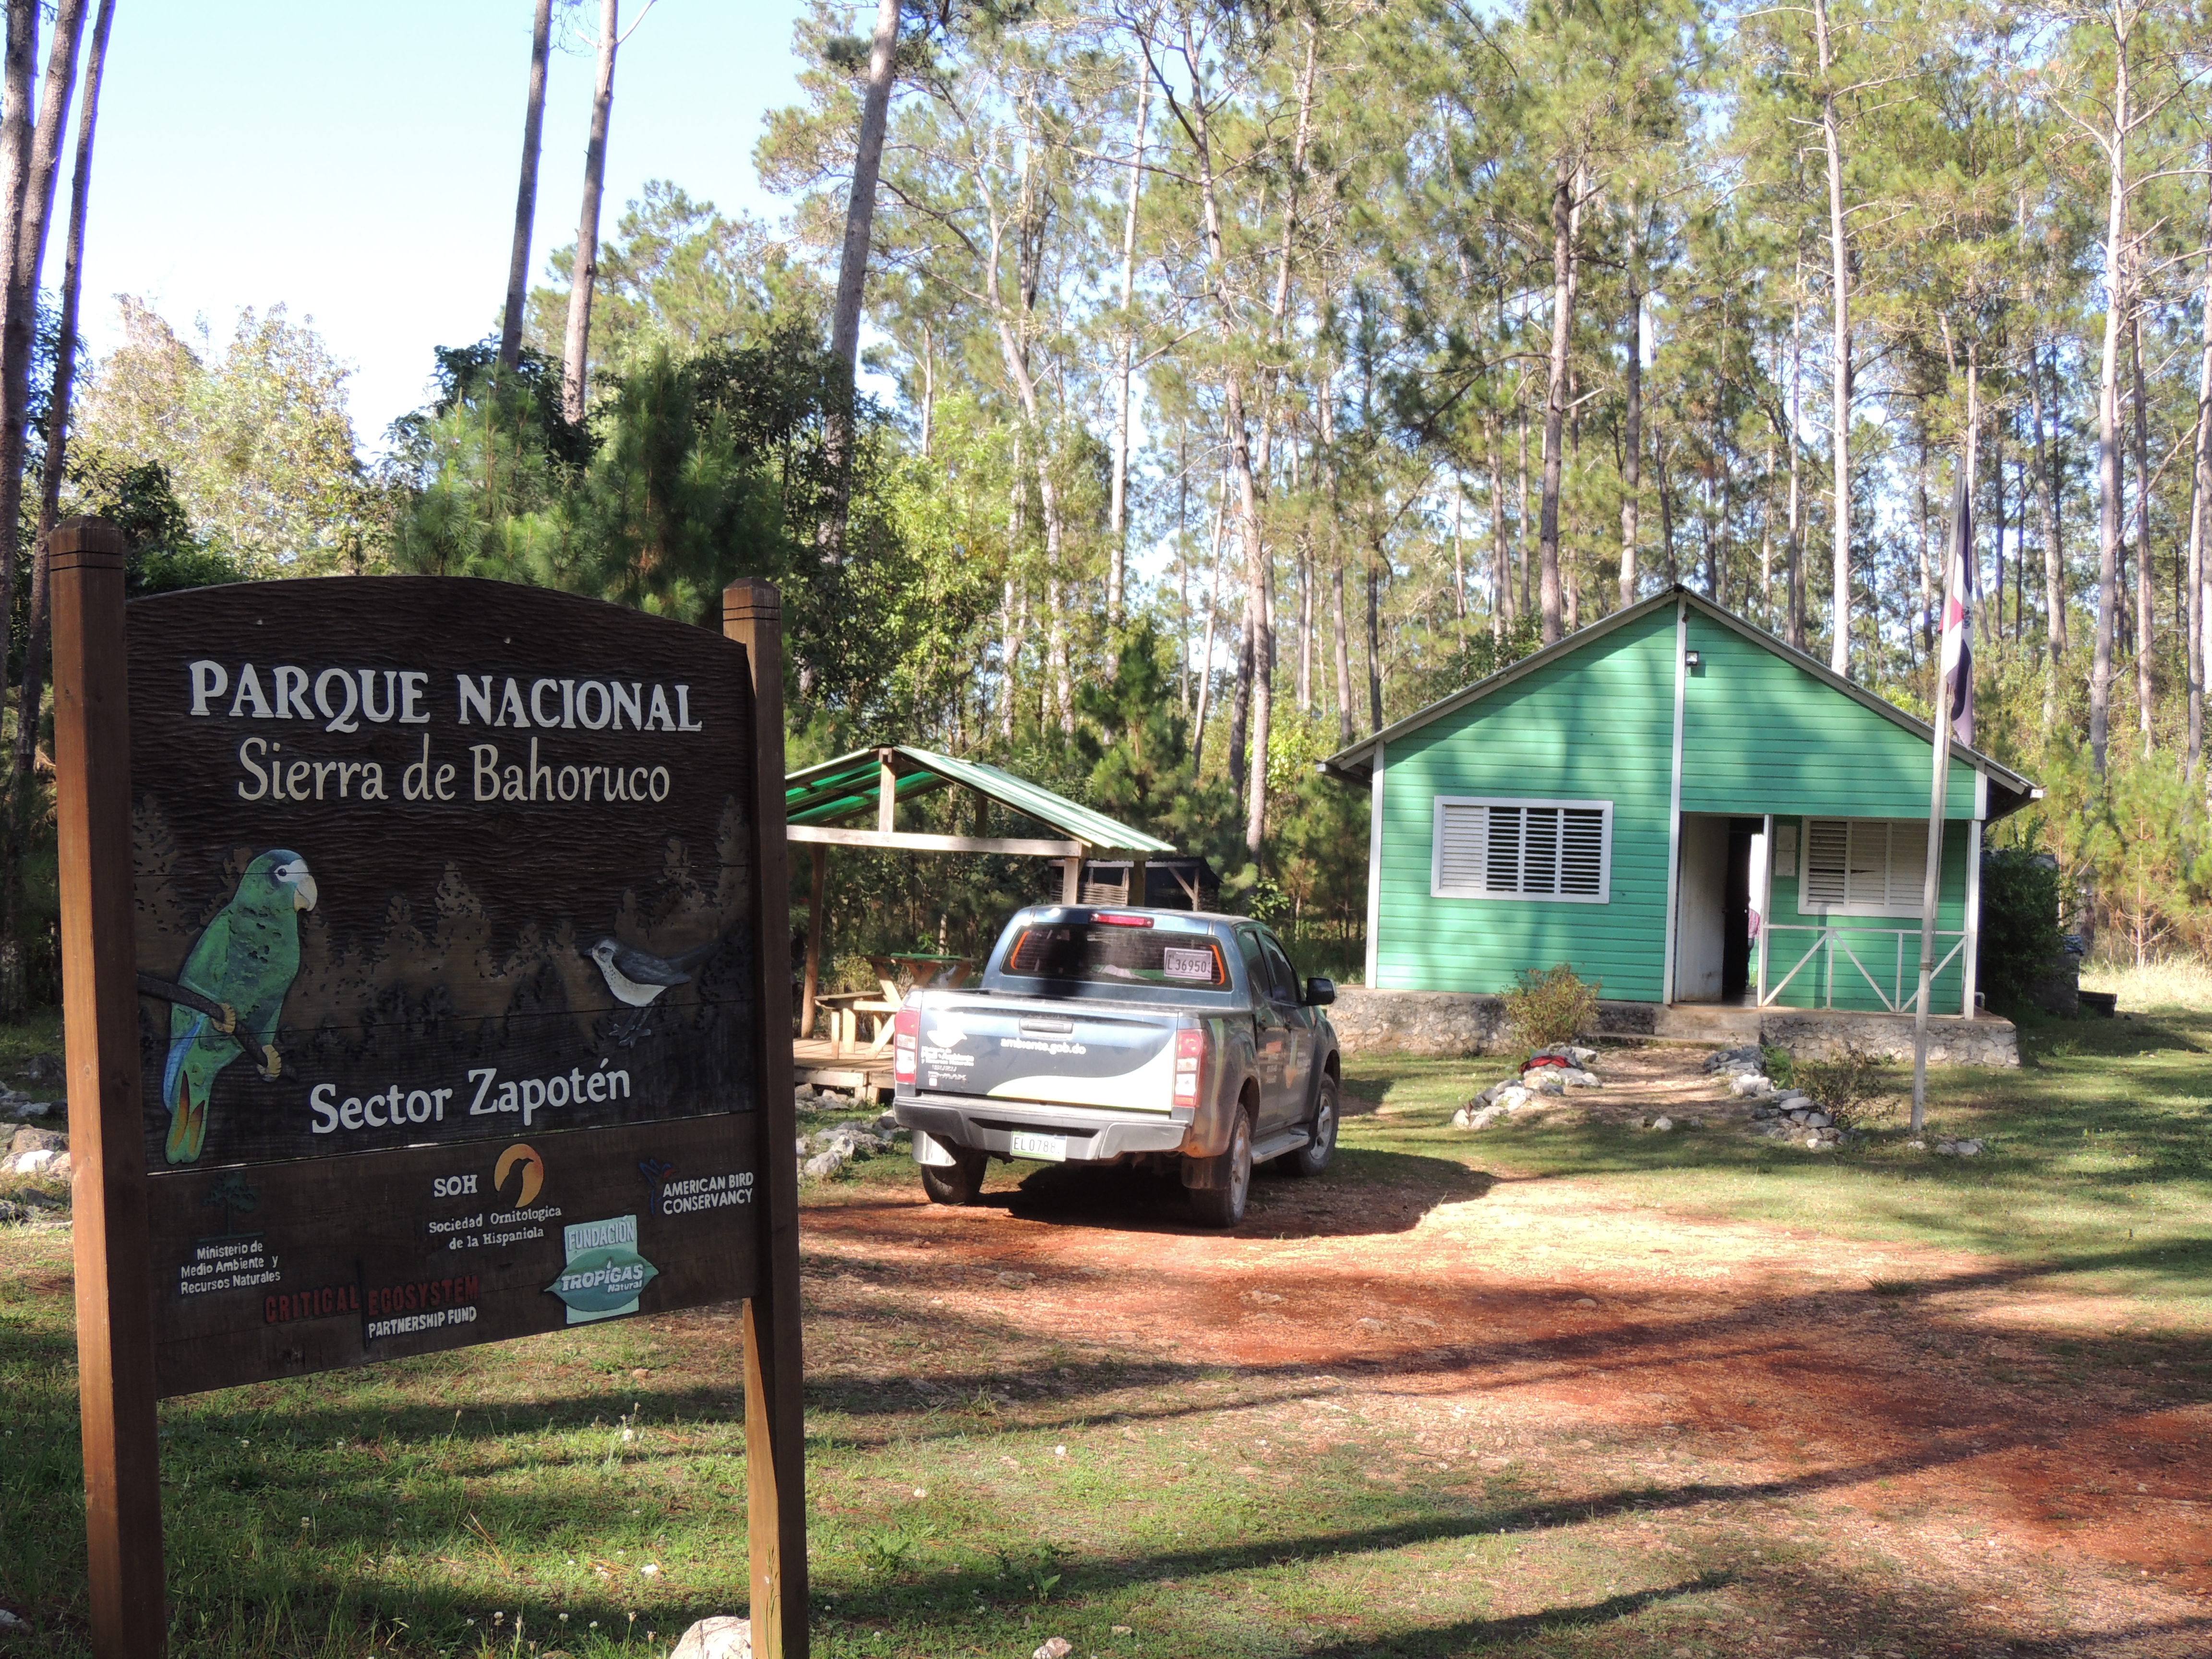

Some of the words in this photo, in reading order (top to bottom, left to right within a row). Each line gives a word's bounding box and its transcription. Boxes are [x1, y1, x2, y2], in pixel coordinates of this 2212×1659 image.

[189, 660, 430, 733] PARQUE
[457, 673, 702, 732] NACIONAL
[238, 737, 388, 801] Sierra
[402, 733, 456, 801] de
[469, 736, 670, 802] Bahoruco
[310, 1083, 453, 1133] Sector
[468, 1058, 630, 1126] Zapotén
[434, 1175, 478, 1198] SOH
[662, 1176, 725, 1197] AMERICAN
[728, 1172, 754, 1189] BIRD
[663, 1188, 753, 1215] CONSERVANCY
[429, 1214, 482, 1234] Sociedad
[490, 1205, 562, 1225] Ornitologica
[197, 1243, 248, 1261] Ministerio
[250, 1239, 263, 1253] de
[449, 1238, 463, 1250] de
[467, 1236, 479, 1248] la
[483, 1227, 544, 1247] Hispaniola
[181, 1262, 213, 1279] Medio
[216, 1257, 264, 1273] Ambiente
[272, 1255, 278, 1268] y
[180, 1279, 230, 1295] Recursos
[232, 1271, 281, 1287] Naturales
[607, 1280, 642, 1293] Natural
[265, 1285, 359, 1323] CRITICAL
[368, 1274, 479, 1317] ECOSYSTEM
[368, 1311, 445, 1339] PARTNERSHIP
[448, 1306, 477, 1325] FUND
